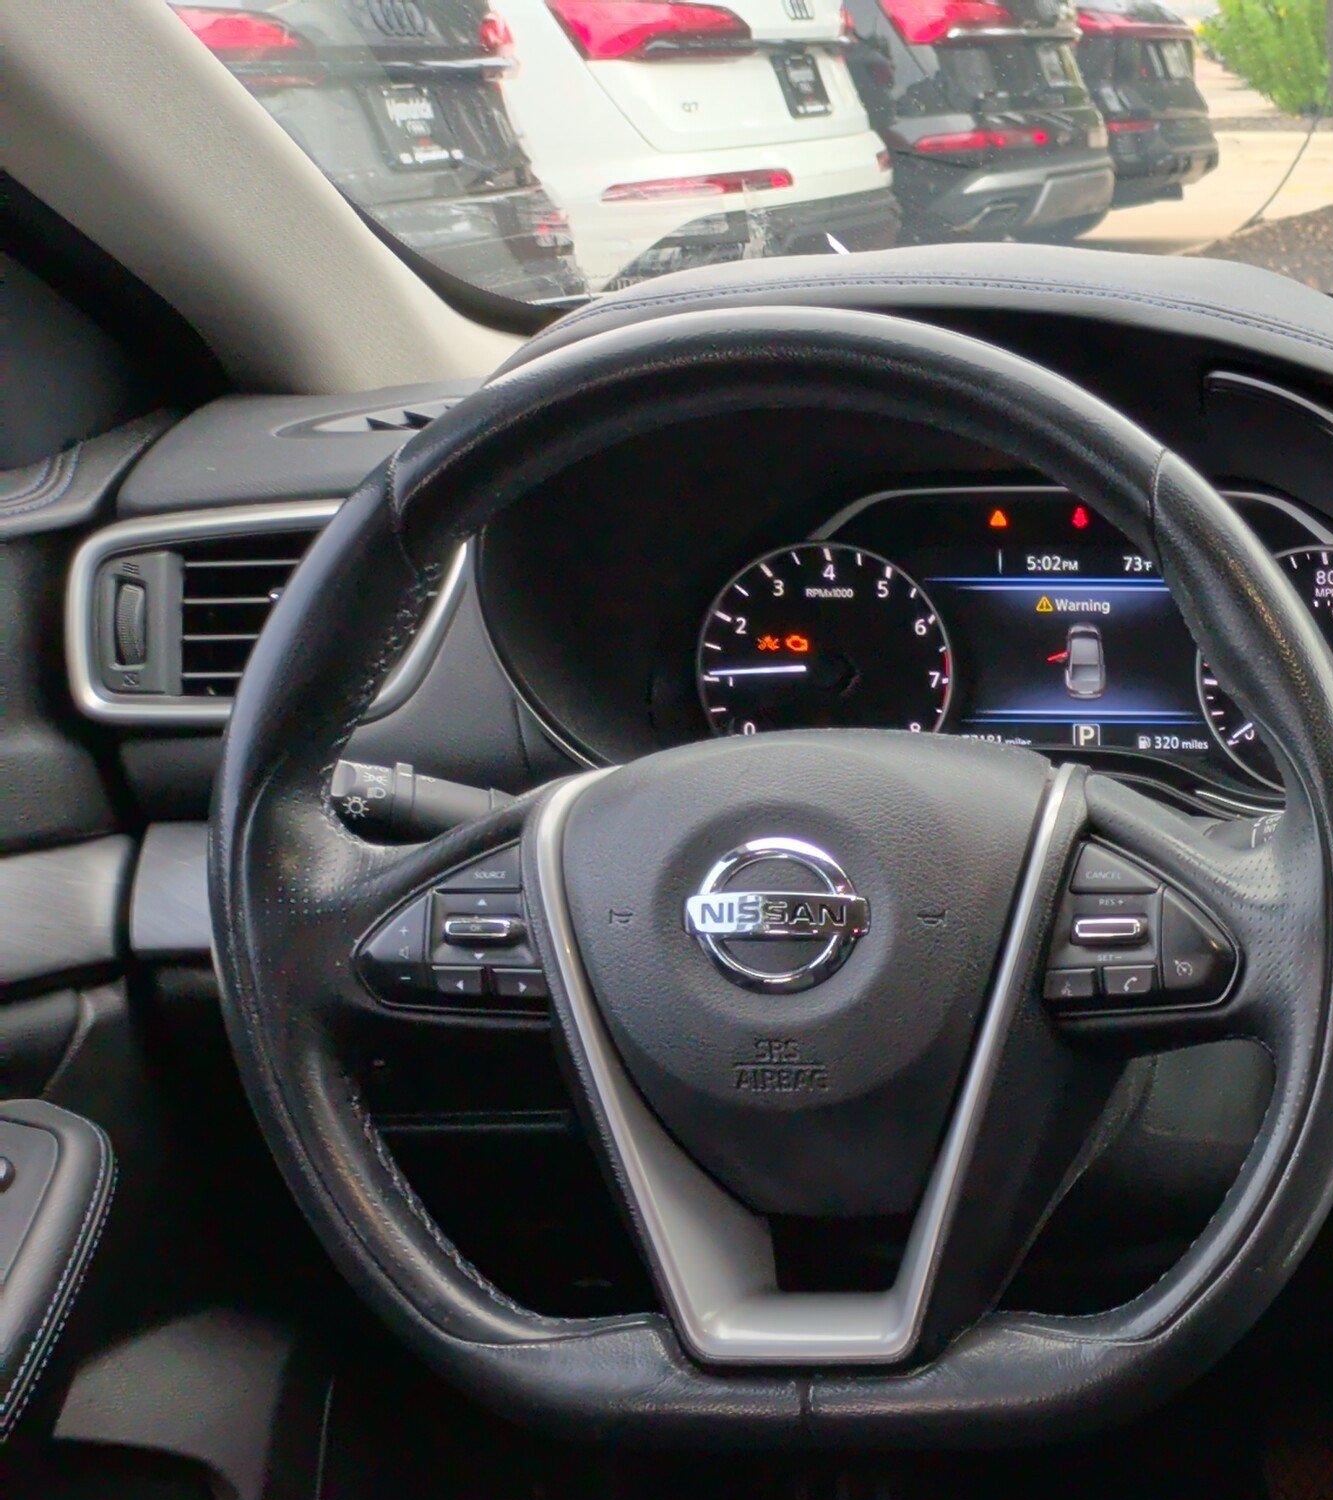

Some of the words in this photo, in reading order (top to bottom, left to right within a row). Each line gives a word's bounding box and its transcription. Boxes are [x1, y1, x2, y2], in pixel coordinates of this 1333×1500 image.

[823, 564, 835, 580] 4
[772, 580, 784, 597] 3
[877, 580, 889, 598] 5
[1055, 599, 1111, 614] Warning
[735, 617, 747, 634] 2
[914, 618, 927, 635] 6
[928, 671, 941, 688] 7
[1080, 726, 1095, 747] P
[1154, 736, 1179, 749] 320
[1181, 737, 1209, 750] miles
[474, 870, 506, 880] SOURCE
[1085, 871, 1122, 880] CANCEL
[700, 902, 847, 926] NISSAN
[754, 1039, 800, 1062] SRS
